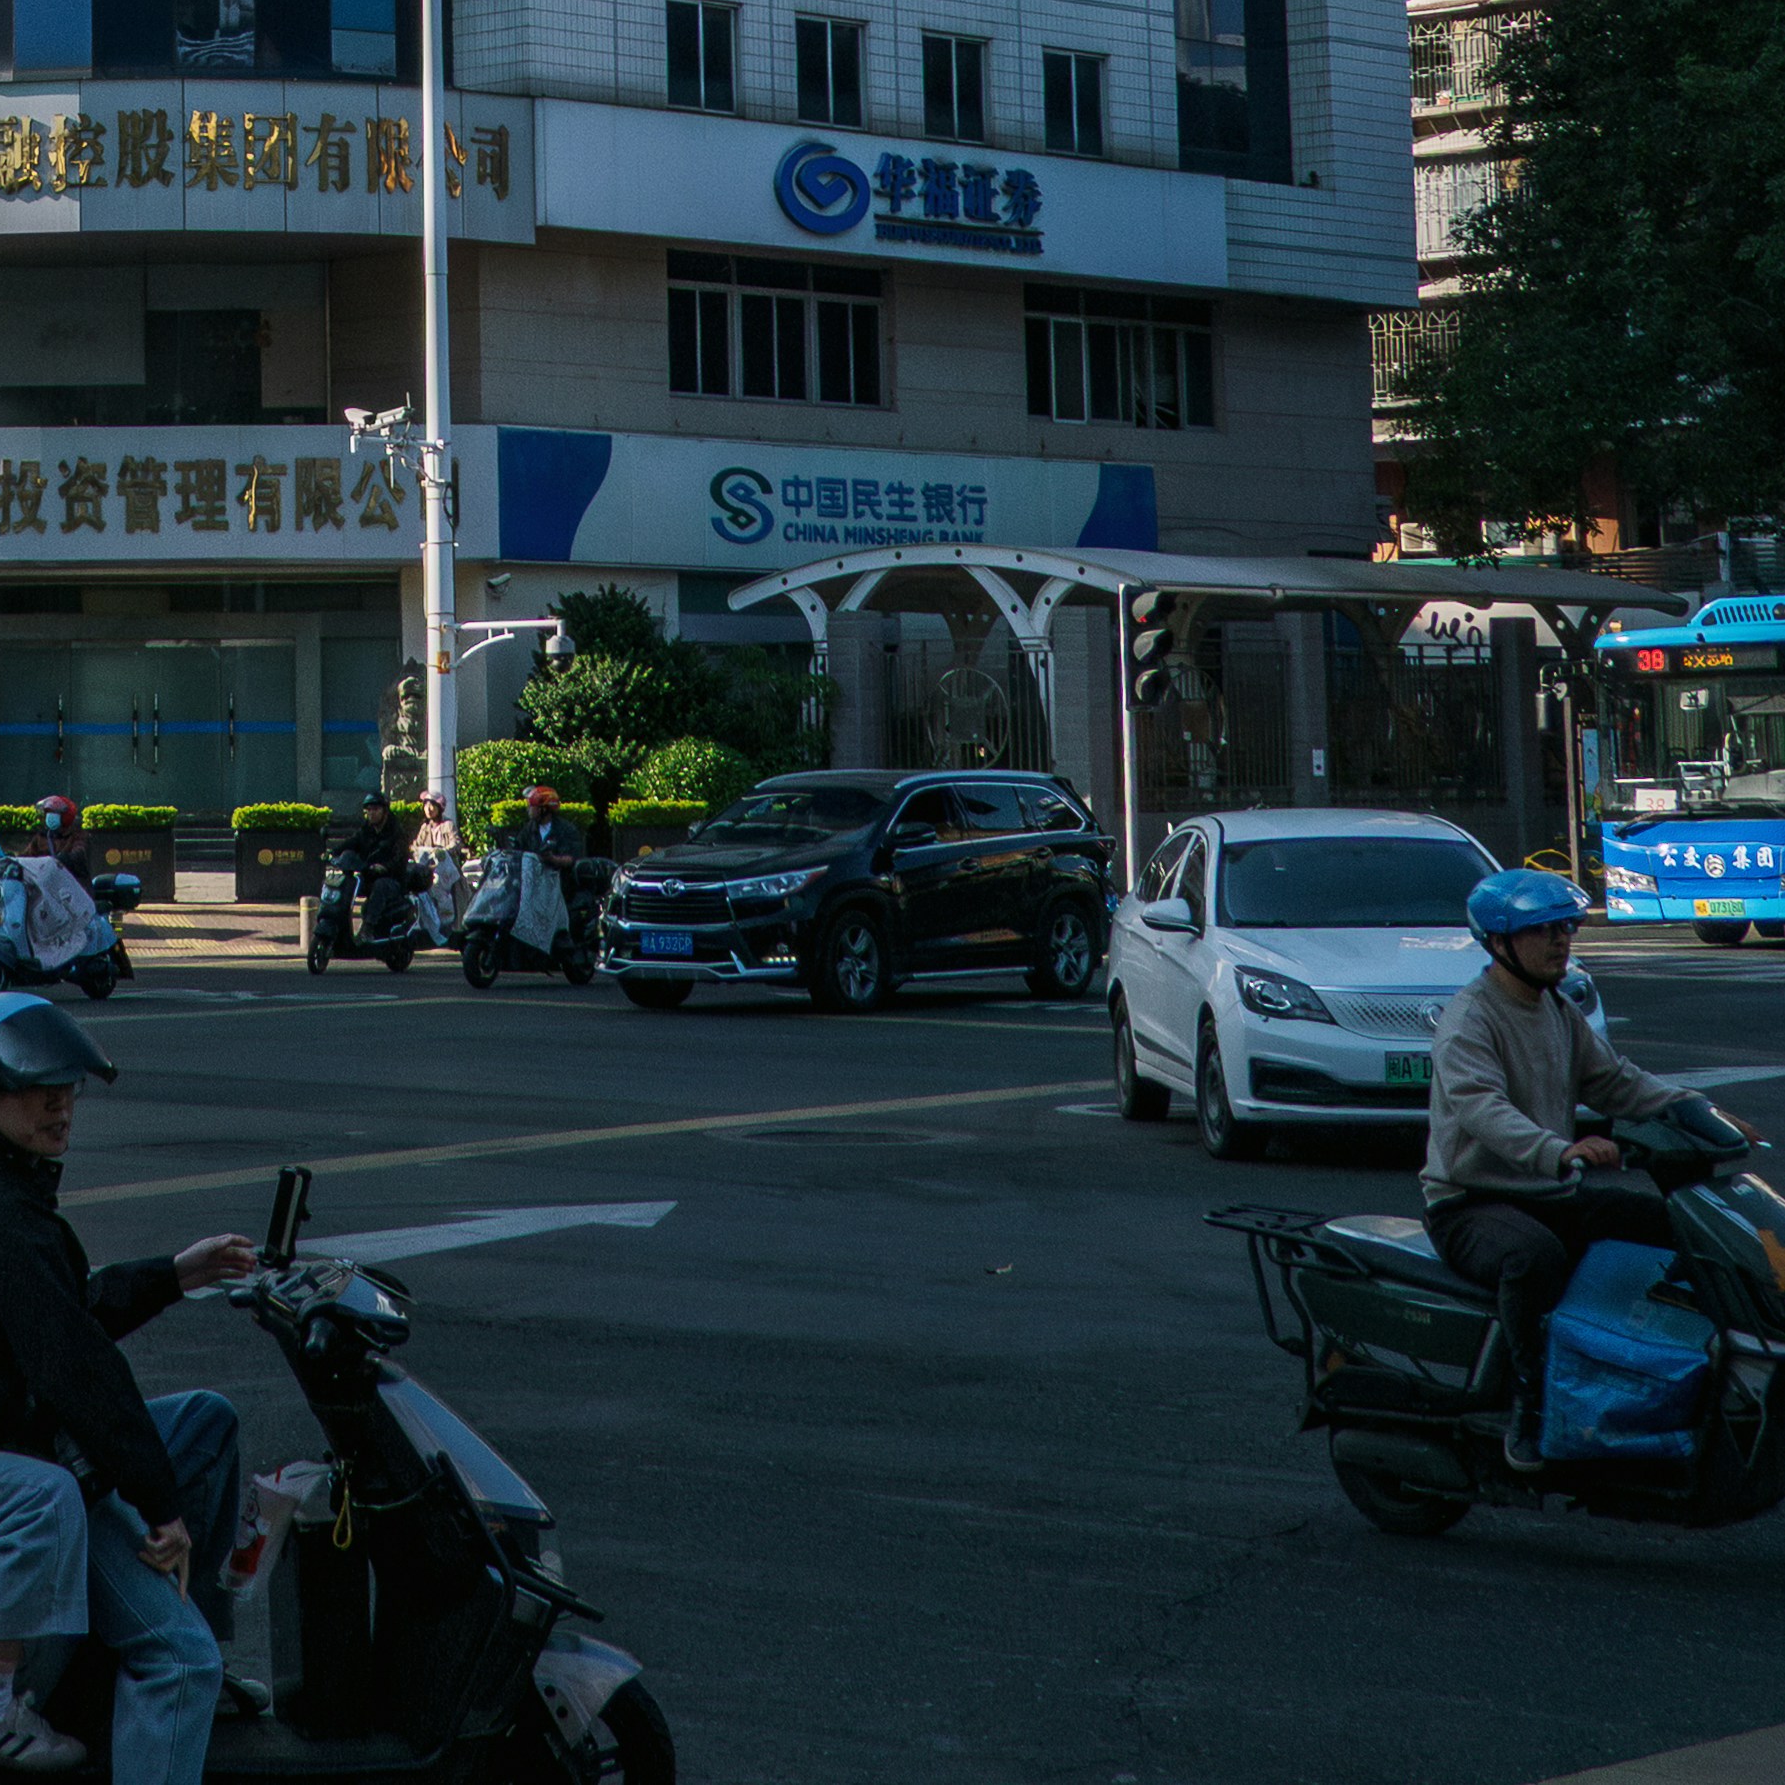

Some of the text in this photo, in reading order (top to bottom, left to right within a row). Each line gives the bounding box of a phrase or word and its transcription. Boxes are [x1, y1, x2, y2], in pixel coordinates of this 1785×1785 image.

[873, 152, 1043, 227] 华福证券
[781, 475, 988, 526] 中国民生银行
[782, 522, 839, 544] CHINA
[1637, 649, 1665, 671] 38
[1645, 797, 1666, 811] 38
[1732, 845, 1774, 869] 集团
